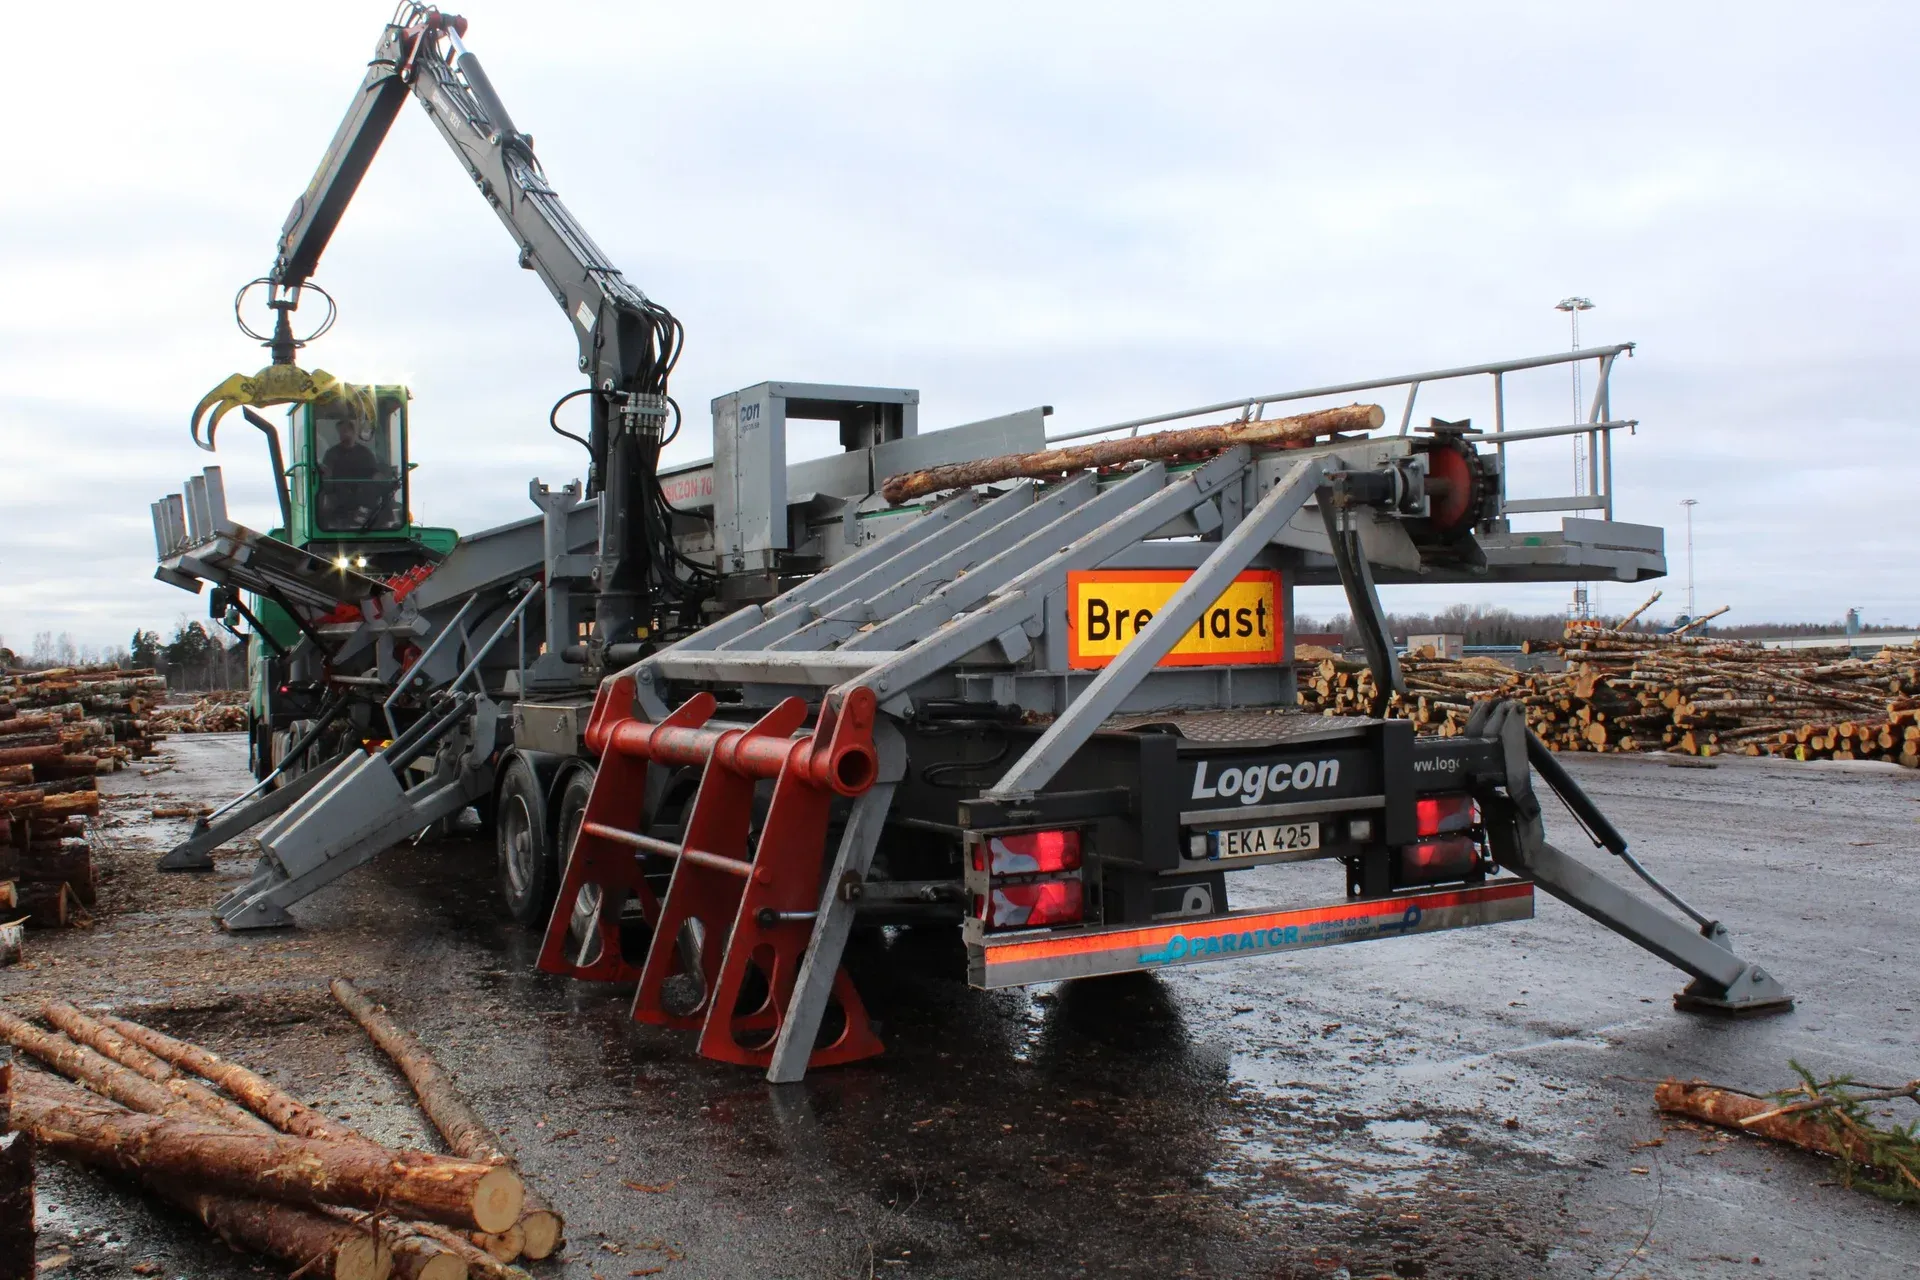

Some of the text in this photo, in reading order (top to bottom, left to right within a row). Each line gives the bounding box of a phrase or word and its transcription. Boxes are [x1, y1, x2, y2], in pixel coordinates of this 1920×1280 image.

[1088, 598, 1154, 641] Bre
[1191, 758, 1340, 805] Logcon
[1227, 825, 1312, 855] EKA 425
[1191, 925, 1299, 957] PARATOR
